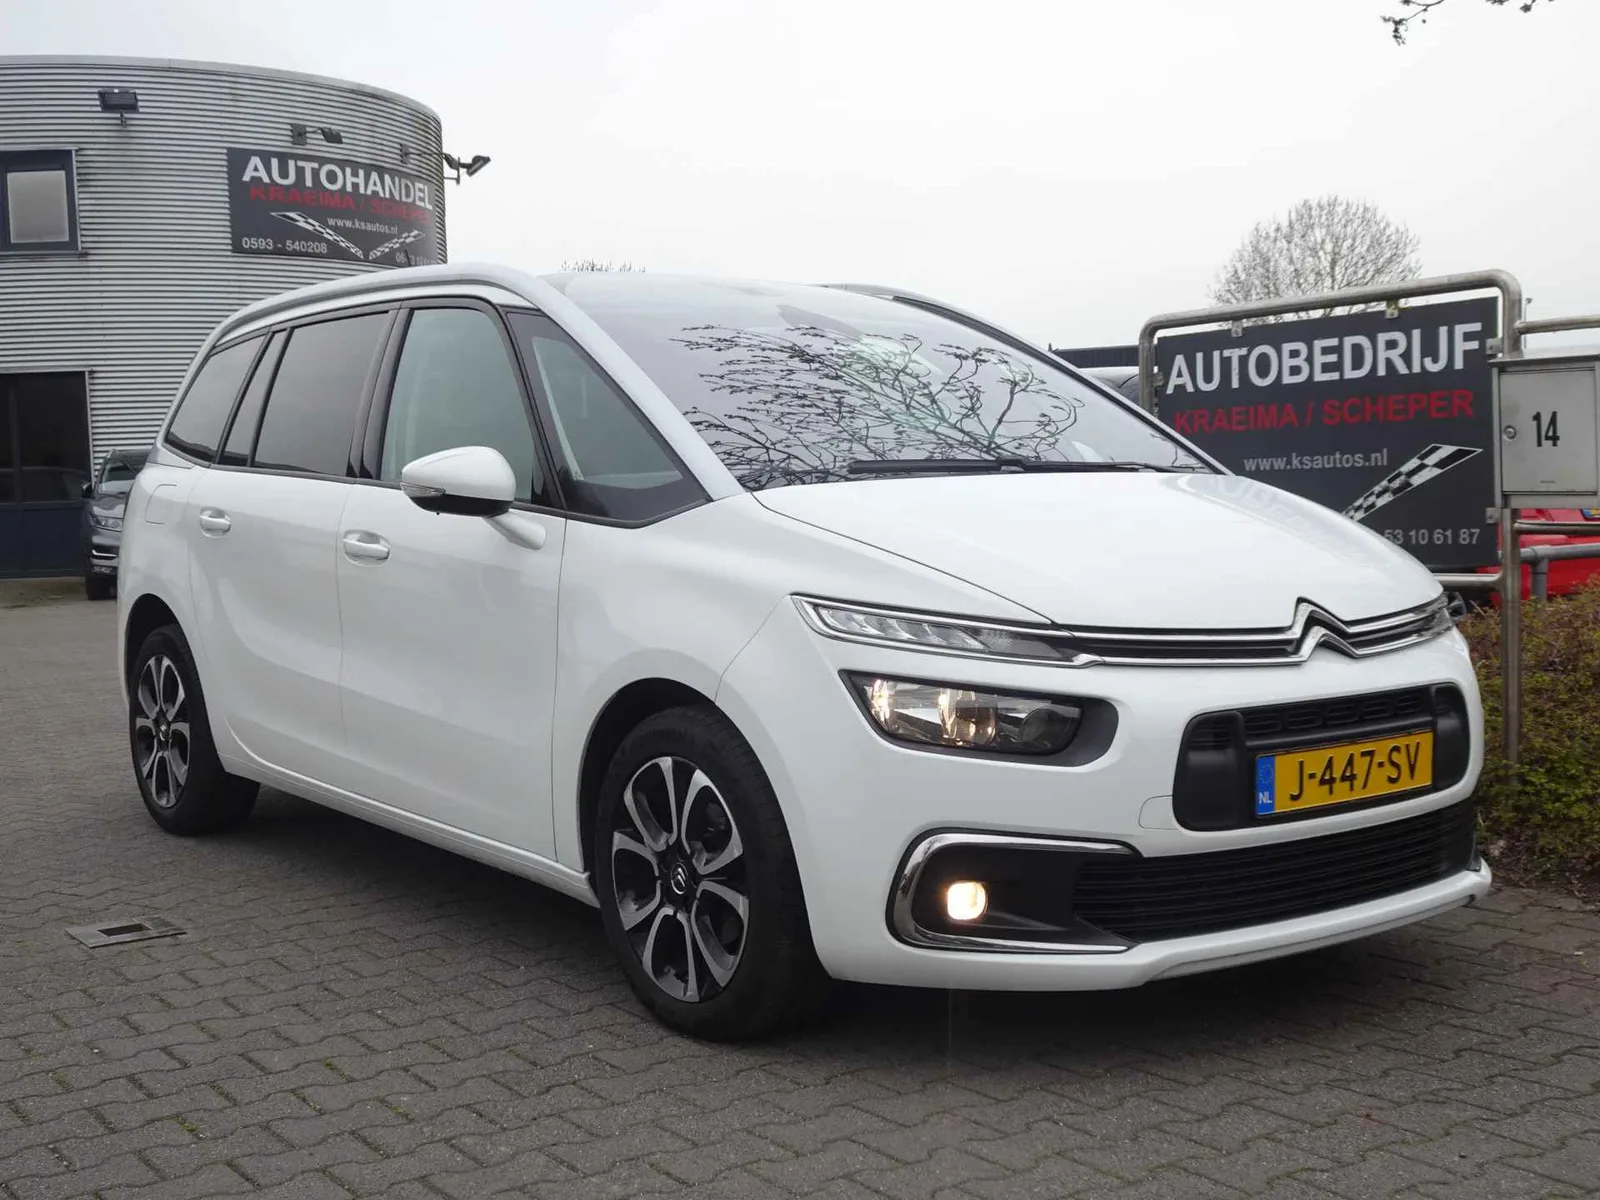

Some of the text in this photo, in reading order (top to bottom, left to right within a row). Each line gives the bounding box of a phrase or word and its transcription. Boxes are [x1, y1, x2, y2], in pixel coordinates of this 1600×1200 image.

[242, 155, 433, 210] AUTOHANDEL
[249, 184, 357, 210] KRAEIMA
[327, 216, 398, 235] www.ksautos.nl
[242, 237, 273, 250] 0593
[285, 240, 328, 254] 540208
[1166, 322, 1482, 395] AUTOBEDRIJF
[1174, 389, 1475, 435] KRAEIMA / SCHEPER
[1532, 411, 1560, 447] 14
[1243, 448, 1388, 471] www.ksautos.nl
[1408, 529, 1429, 545] 10
[1433, 529, 1453, 545] 61
[1459, 528, 1481, 545] 87
[1289, 741, 1421, 802] J-447-SV
[1258, 791, 1273, 804] NL
